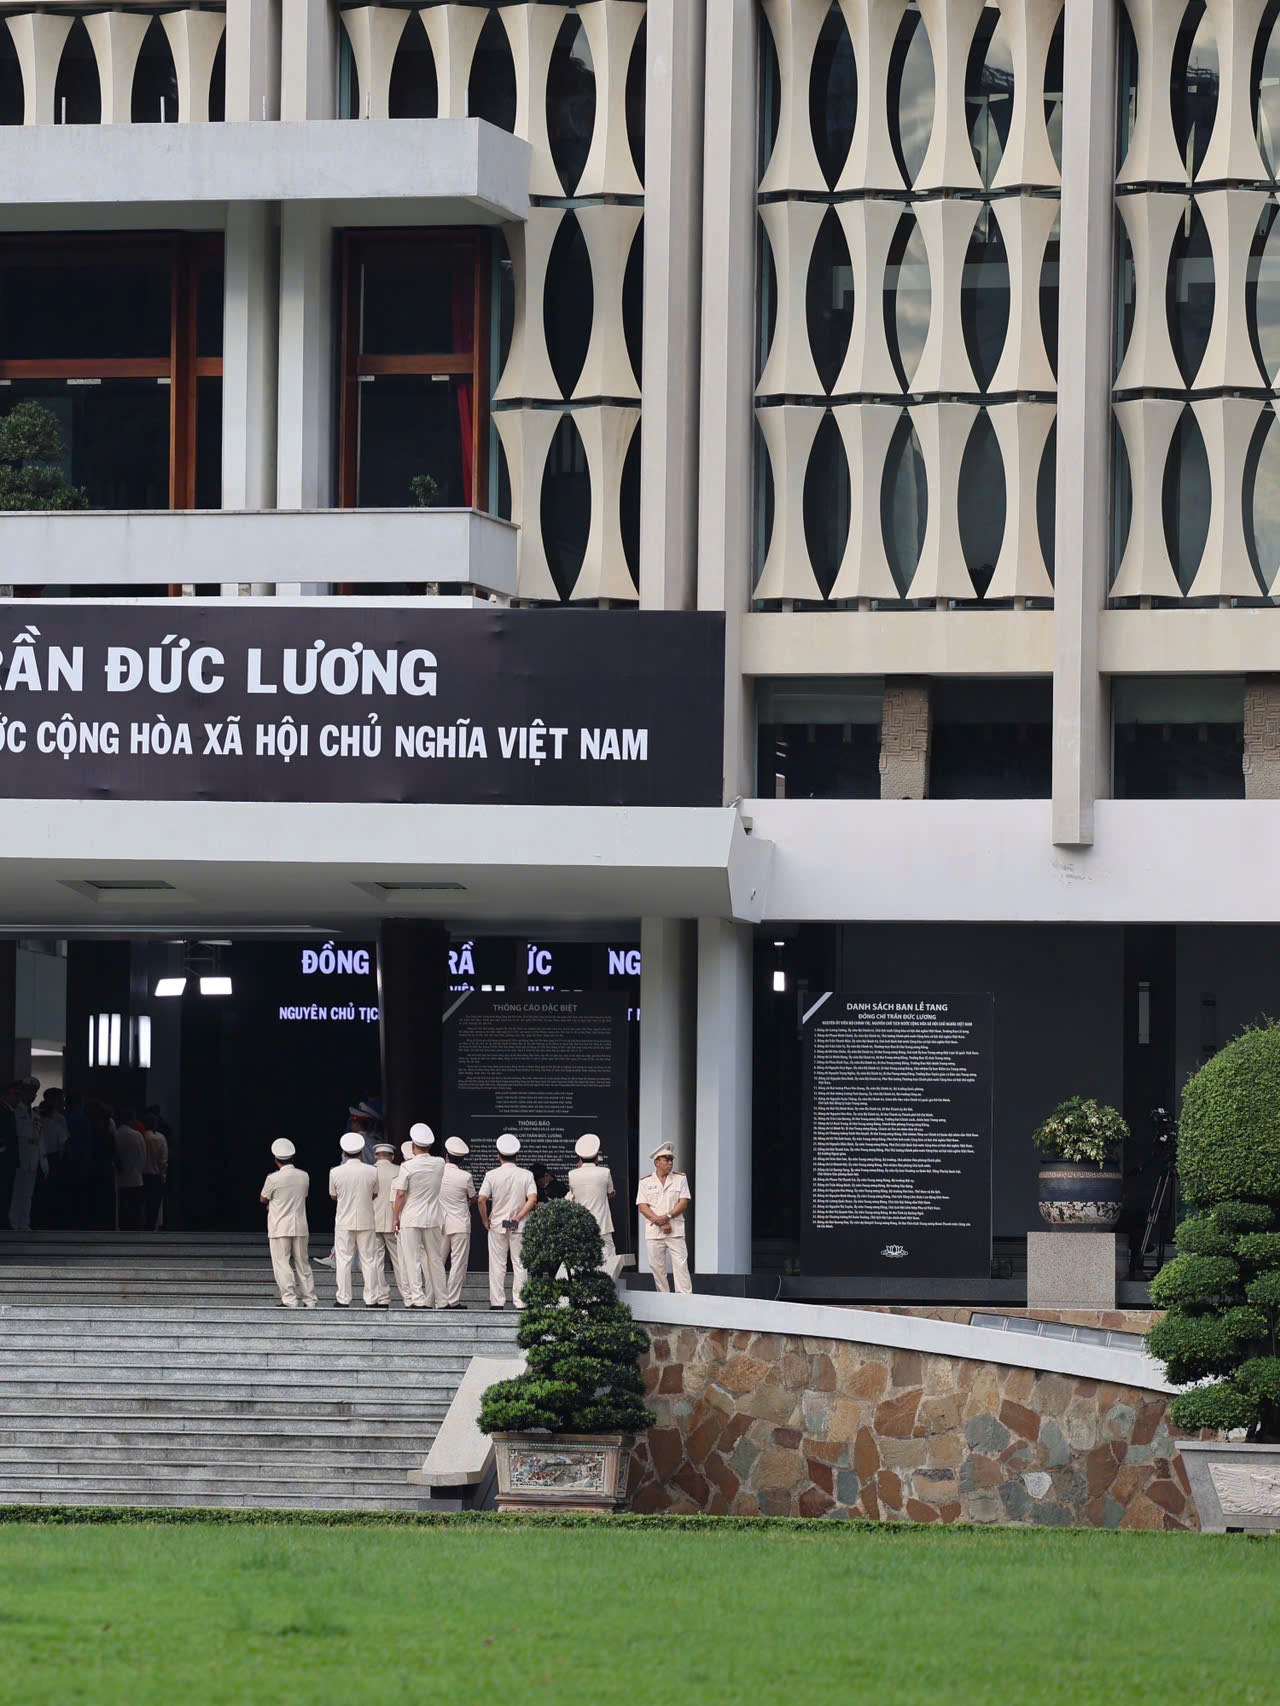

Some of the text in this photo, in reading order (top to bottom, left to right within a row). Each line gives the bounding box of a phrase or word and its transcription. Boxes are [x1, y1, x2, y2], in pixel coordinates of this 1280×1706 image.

[105, 634, 225, 694] ĐỨC
[247, 640, 438, 696] LƯƠNG
[36, 712, 120, 760] CỘNG
[131, 714, 193, 756] HÒA
[203, 715, 244, 756] XÃ
[256, 715, 309, 763] HỘI
[320, 712, 382, 758] CHỦ
[395, 718, 488, 759] NGHĨA
[498, 718, 569, 766] VIỆT
[580, 728, 648, 761] NAM
[301, 940, 370, 975] ĐỒNG
[279, 1002, 380, 1023] NGUYÊN CHỦ TỊC
[493, 1003, 577, 1013] THÔNG CÁO ĐẶC BIỆT
[846, 1003, 871, 1011] DANH
[872, 1002, 894, 1011] SÁCH
[895, 1003, 913, 1011] BAN
[915, 1001, 925, 1011] LỄ
